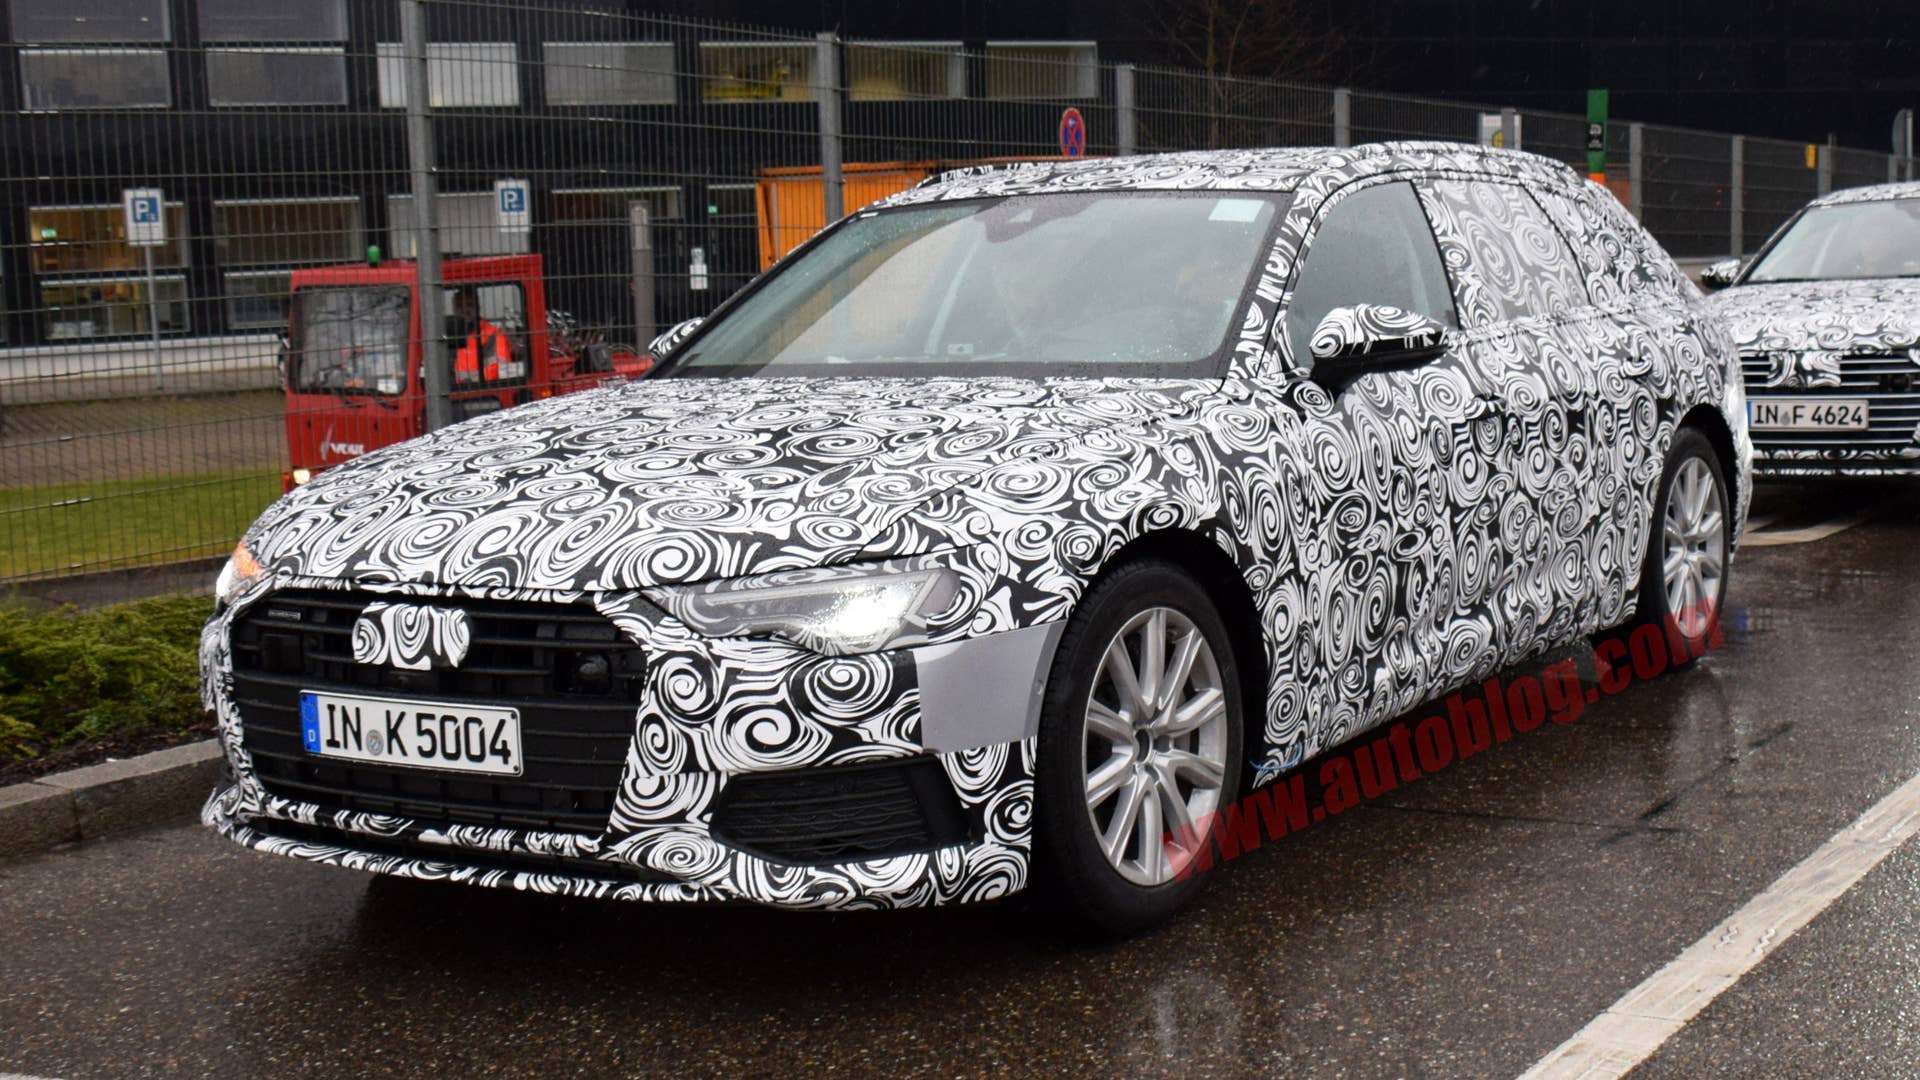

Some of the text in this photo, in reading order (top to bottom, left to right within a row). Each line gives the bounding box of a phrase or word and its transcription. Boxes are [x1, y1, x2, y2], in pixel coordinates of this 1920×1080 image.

[135, 200, 150, 220] P
[503, 190, 518, 210] P
[1754, 405, 1778, 424] IN
[1811, 405, 1863, 425] 4624
[326, 703, 363, 751] IN
